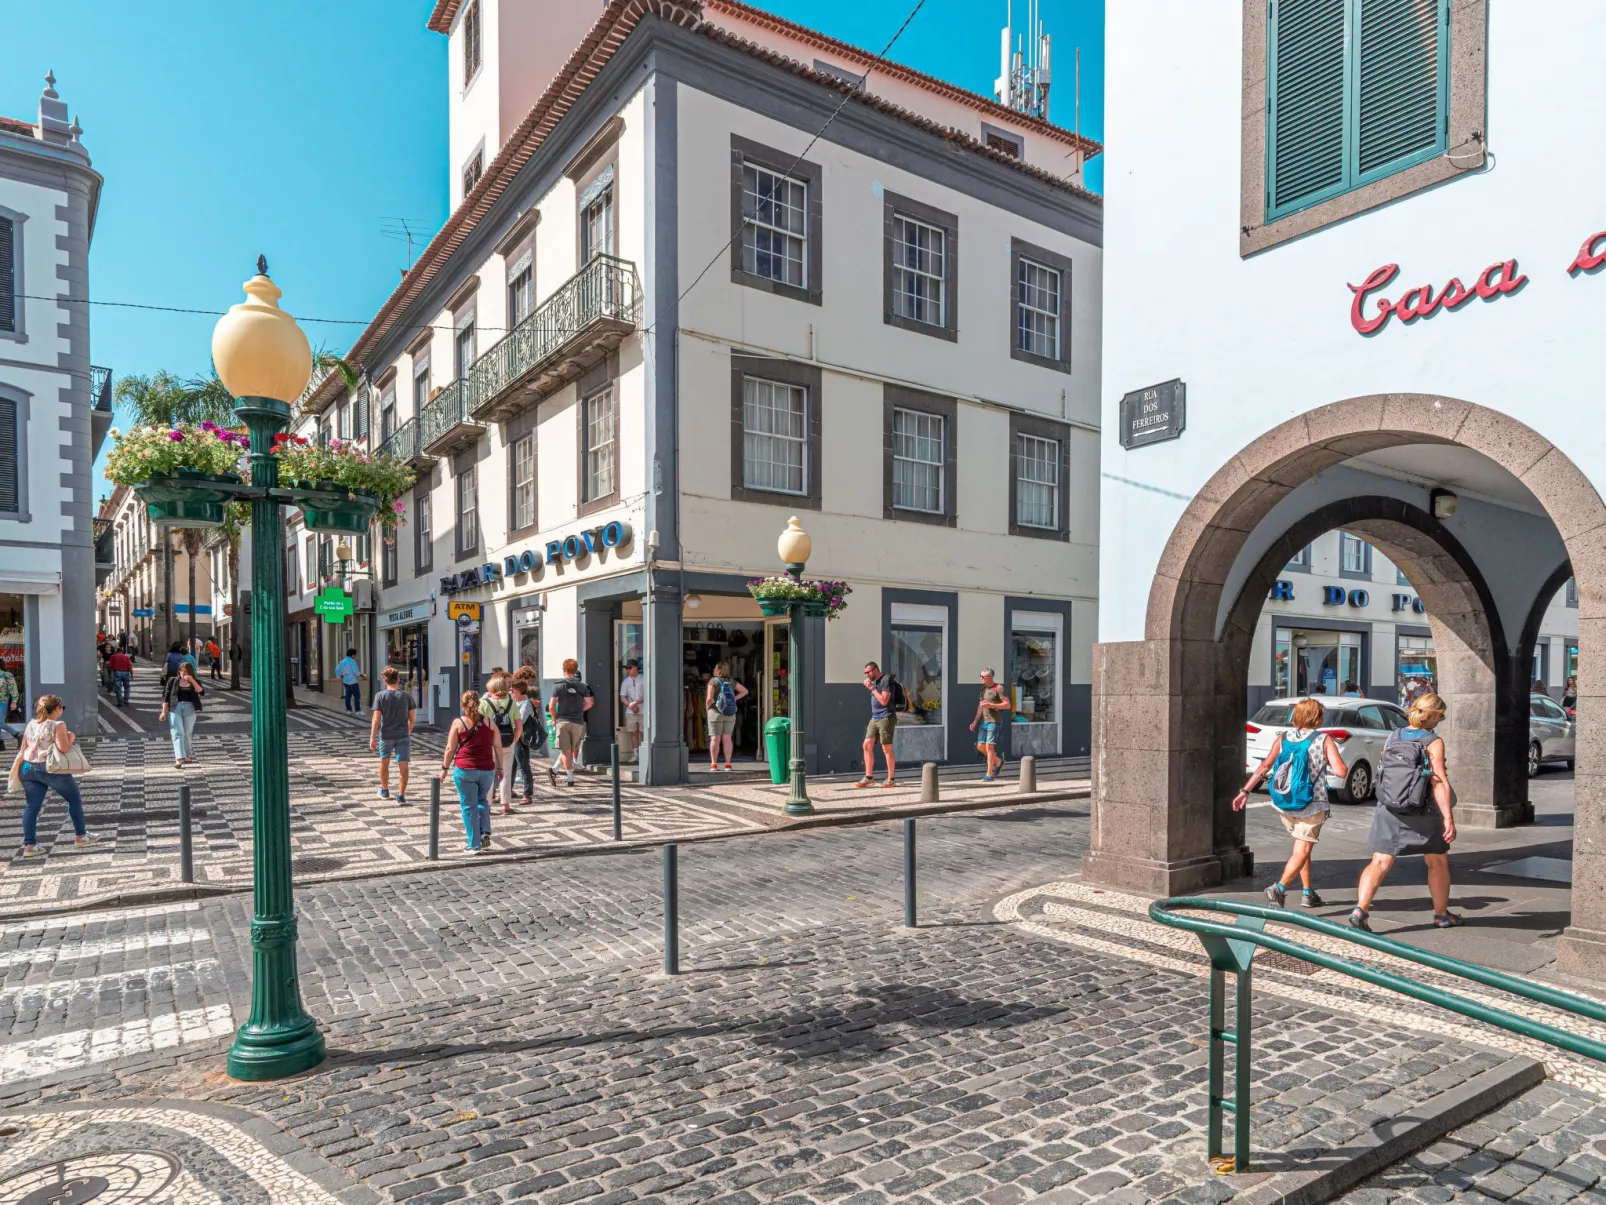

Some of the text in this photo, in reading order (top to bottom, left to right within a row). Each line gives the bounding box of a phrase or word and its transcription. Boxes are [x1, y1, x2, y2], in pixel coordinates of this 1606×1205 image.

[1346, 257, 1528, 334] Casa
[1143, 390, 1158, 401] RUA
[1143, 402, 1158, 414] DOS
[1132, 412, 1169, 430] FERREIROS
[440, 520, 627, 596] BAZAR DO POVO
[1323, 585, 1370, 608] DO
